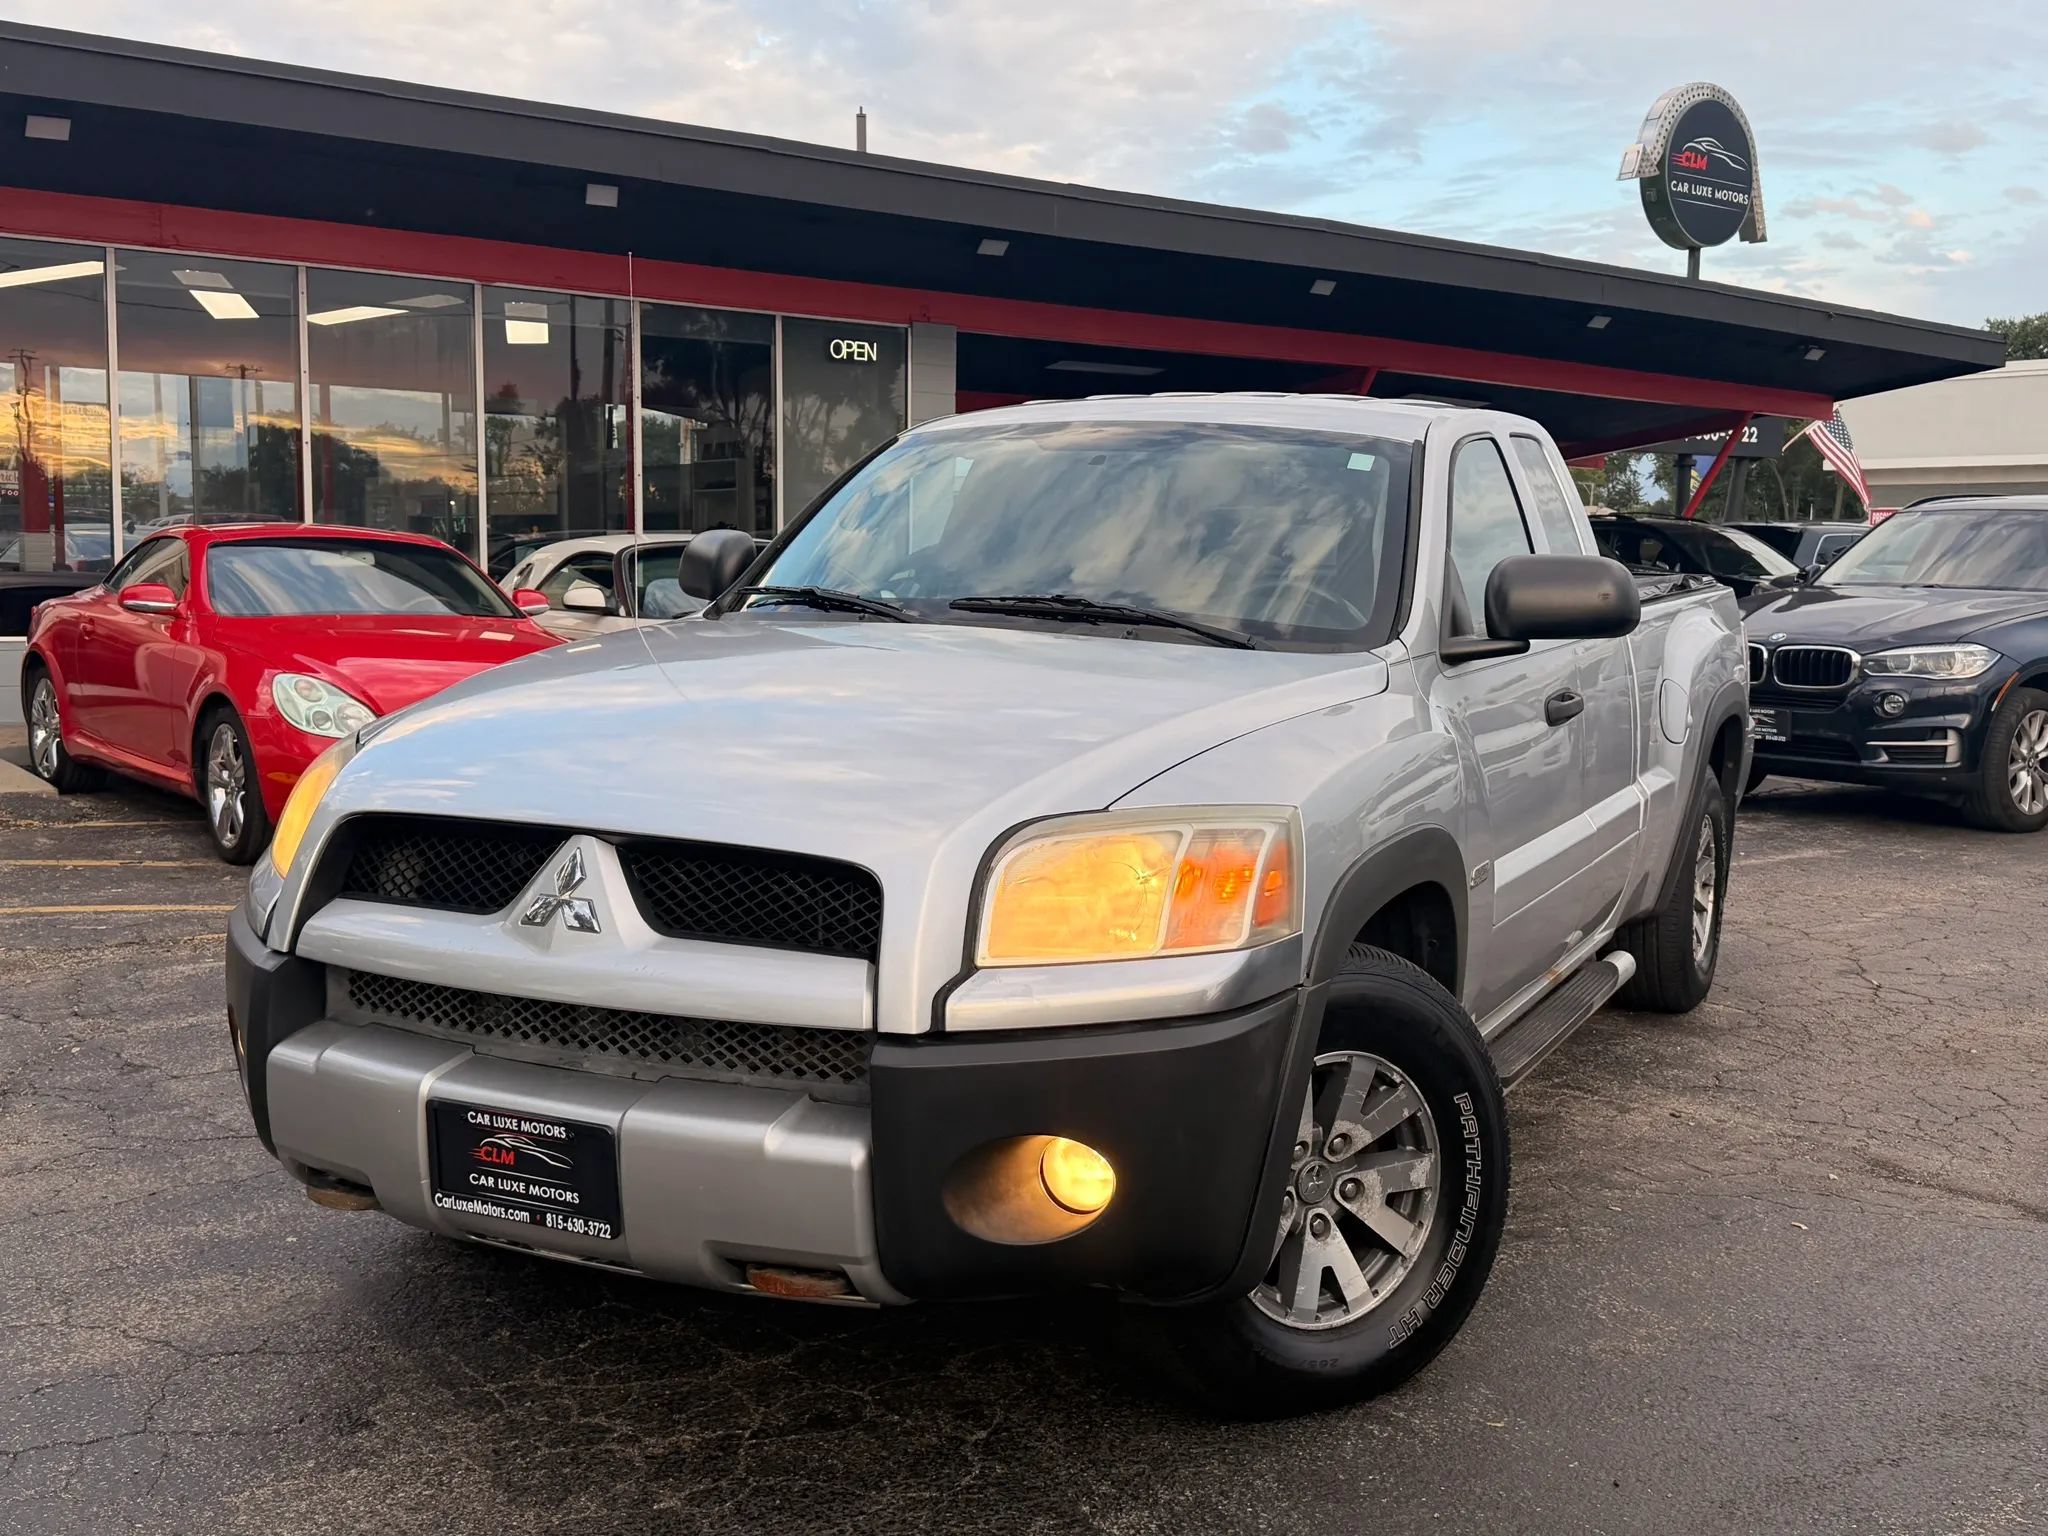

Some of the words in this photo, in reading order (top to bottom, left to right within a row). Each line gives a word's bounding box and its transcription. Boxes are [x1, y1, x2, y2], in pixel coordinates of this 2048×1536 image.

[1682, 151, 1708, 170] CLM
[1670, 180, 1689, 193] CAR
[1691, 184, 1713, 198] LUXE
[1714, 189, 1749, 205] MOTORS
[830, 338, 877, 362] OPEN
[467, 1111, 491, 1127] CAR
[493, 1115, 519, 1130] LUXE
[520, 1120, 567, 1139] MOTORS
[480, 1146, 515, 1166] CLM
[469, 1173, 495, 1188] CAR
[498, 1178, 526, 1194] LUXE
[529, 1185, 580, 1204] MOTORS
[1423, 1091, 1482, 1310] PATHFINDER
[434, 1193, 530, 1224] CarLuxeMotors.com
[546, 1213, 612, 1239] 815-630-3722
[1387, 1306, 1424, 1349] HT
